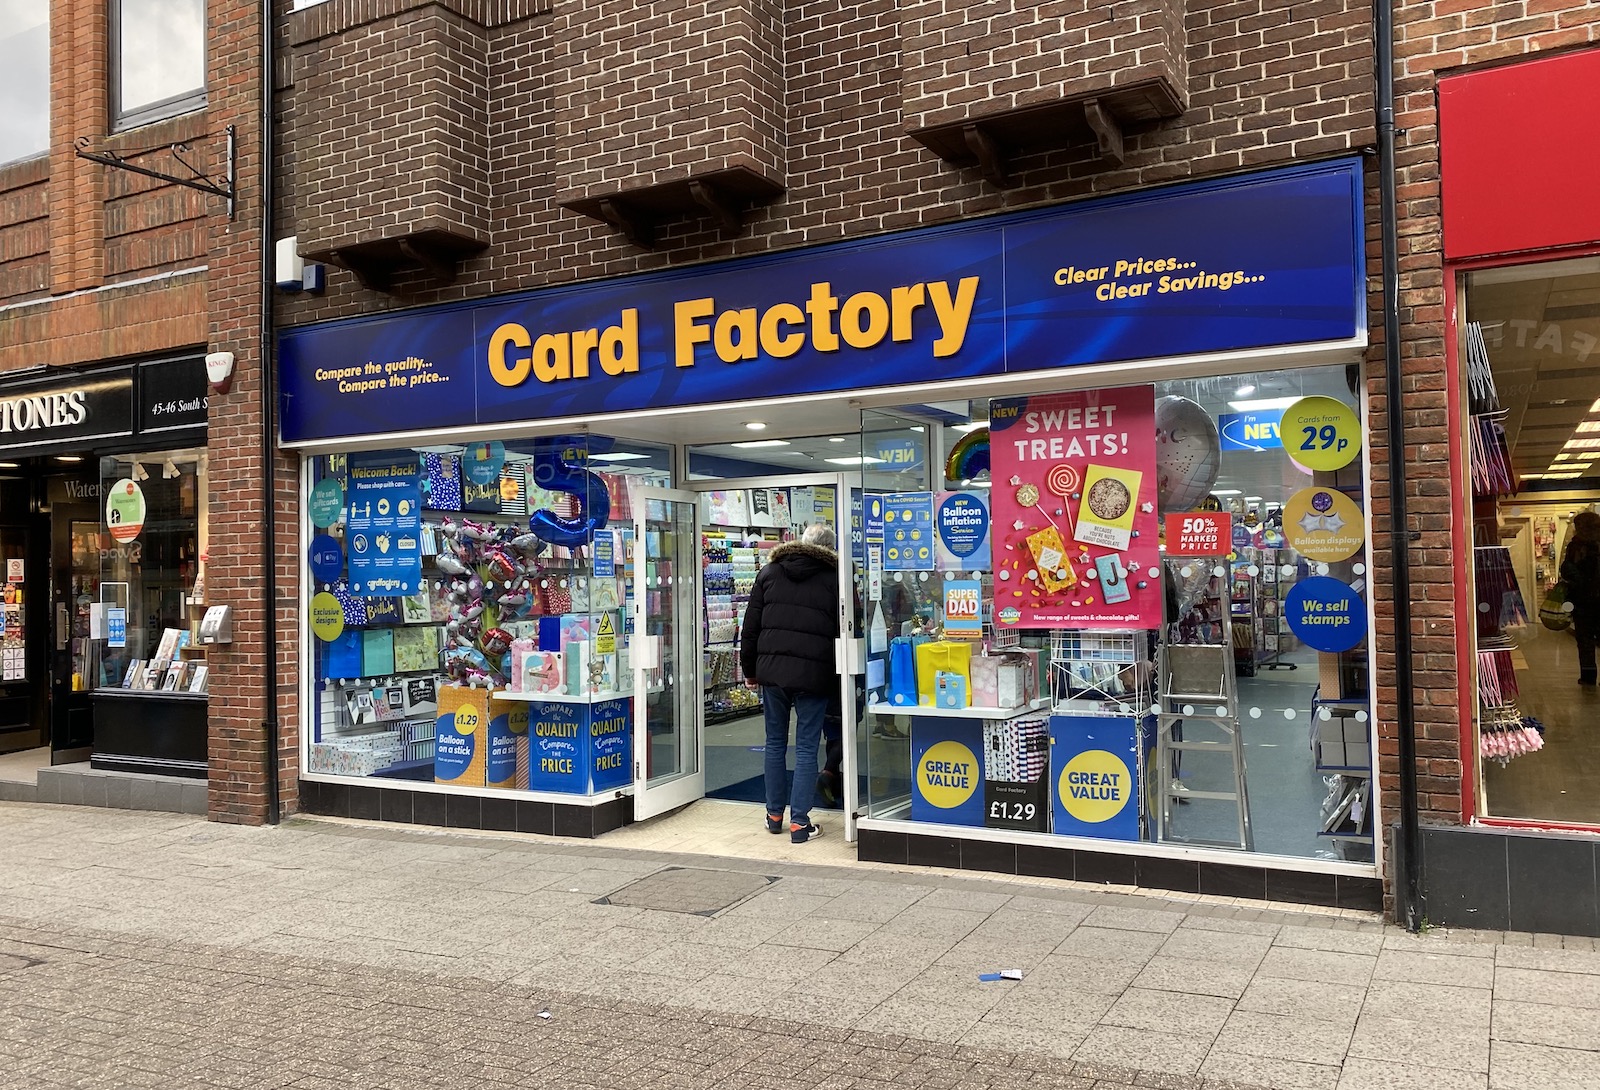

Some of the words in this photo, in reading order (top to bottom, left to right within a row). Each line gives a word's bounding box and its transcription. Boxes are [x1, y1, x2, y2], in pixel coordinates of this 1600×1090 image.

[1054, 266, 1109, 286] Clear
[1114, 256, 1197, 278] Prices...
[1095, 280, 1152, 302] Clear
[1157, 270, 1265, 294] Savings...
[487, 308, 639, 387] Card
[674, 276, 980, 368] Factory
[207, 360, 227, 368] KINGS
[315, 367, 362, 381] Compare
[364, 361, 382, 375] the
[385, 356, 433, 375] quality...
[338, 378, 387, 393] Compare
[389, 373, 408, 387] the
[409, 370, 450, 388] price...
[151, 401, 176, 416] 45-46
[177, 397, 200, 412] South
[992, 407, 1018, 418] NEW
[1025, 405, 1117, 434] SWEET
[1297, 416, 1321, 424] Cards
[1322, 414, 1341, 422] from
[1300, 424, 1348, 452] 29p
[1014, 432, 1128, 461] TREATS!
[351, 467, 389, 479] Welcome
[390, 464, 417, 477] Back!
[356, 481, 371, 489] Please
[371, 481, 383, 489] shop
[383, 480, 394, 488] with
[315, 490, 325, 498] We
[325, 488, 336, 497] sell
[943, 506, 982, 517] Balloon
[943, 516, 982, 526] Inflation
[1182, 517, 1216, 534] 50%
[1094, 525, 1113, 535] BECAUSE
[1095, 538, 1120, 548] CHOCOLATE
[1180, 535, 1218, 543] MARKED
[1294, 536, 1326, 546] Balloon
[1326, 536, 1362, 546] displays
[1180, 542, 1218, 550] PRICE
[1303, 546, 1334, 554] available
[948, 588, 979, 599] SUPER
[313, 607, 340, 616] Exclusive
[948, 599, 979, 614] DAD
[1302, 599, 1324, 612] We
[1325, 599, 1349, 612] sell
[315, 615, 337, 626] designs
[1124, 614, 1140, 622] gifts!
[1301, 614, 1350, 628] stamps
[540, 703, 574, 718] COMPARE
[594, 700, 622, 715] COMPARE
[456, 714, 478, 726] £1.29
[510, 711, 529, 724] £1.29
[535, 722, 579, 738] QUALITY
[591, 717, 626, 737] QUALITY
[438, 734, 465, 746] Balloon
[453, 745, 471, 755] stick
[492, 748, 501, 756] on
[541, 758, 573, 774] PRICE
[596, 752, 622, 772] PRICE
[925, 759, 970, 776] GREAT
[926, 773, 970, 789] VALUE
[1067, 771, 1120, 787] GREAT
[1008, 786, 1027, 795] Factory
[1069, 785, 1121, 802] VALUE
[990, 800, 1036, 821] £1.29
